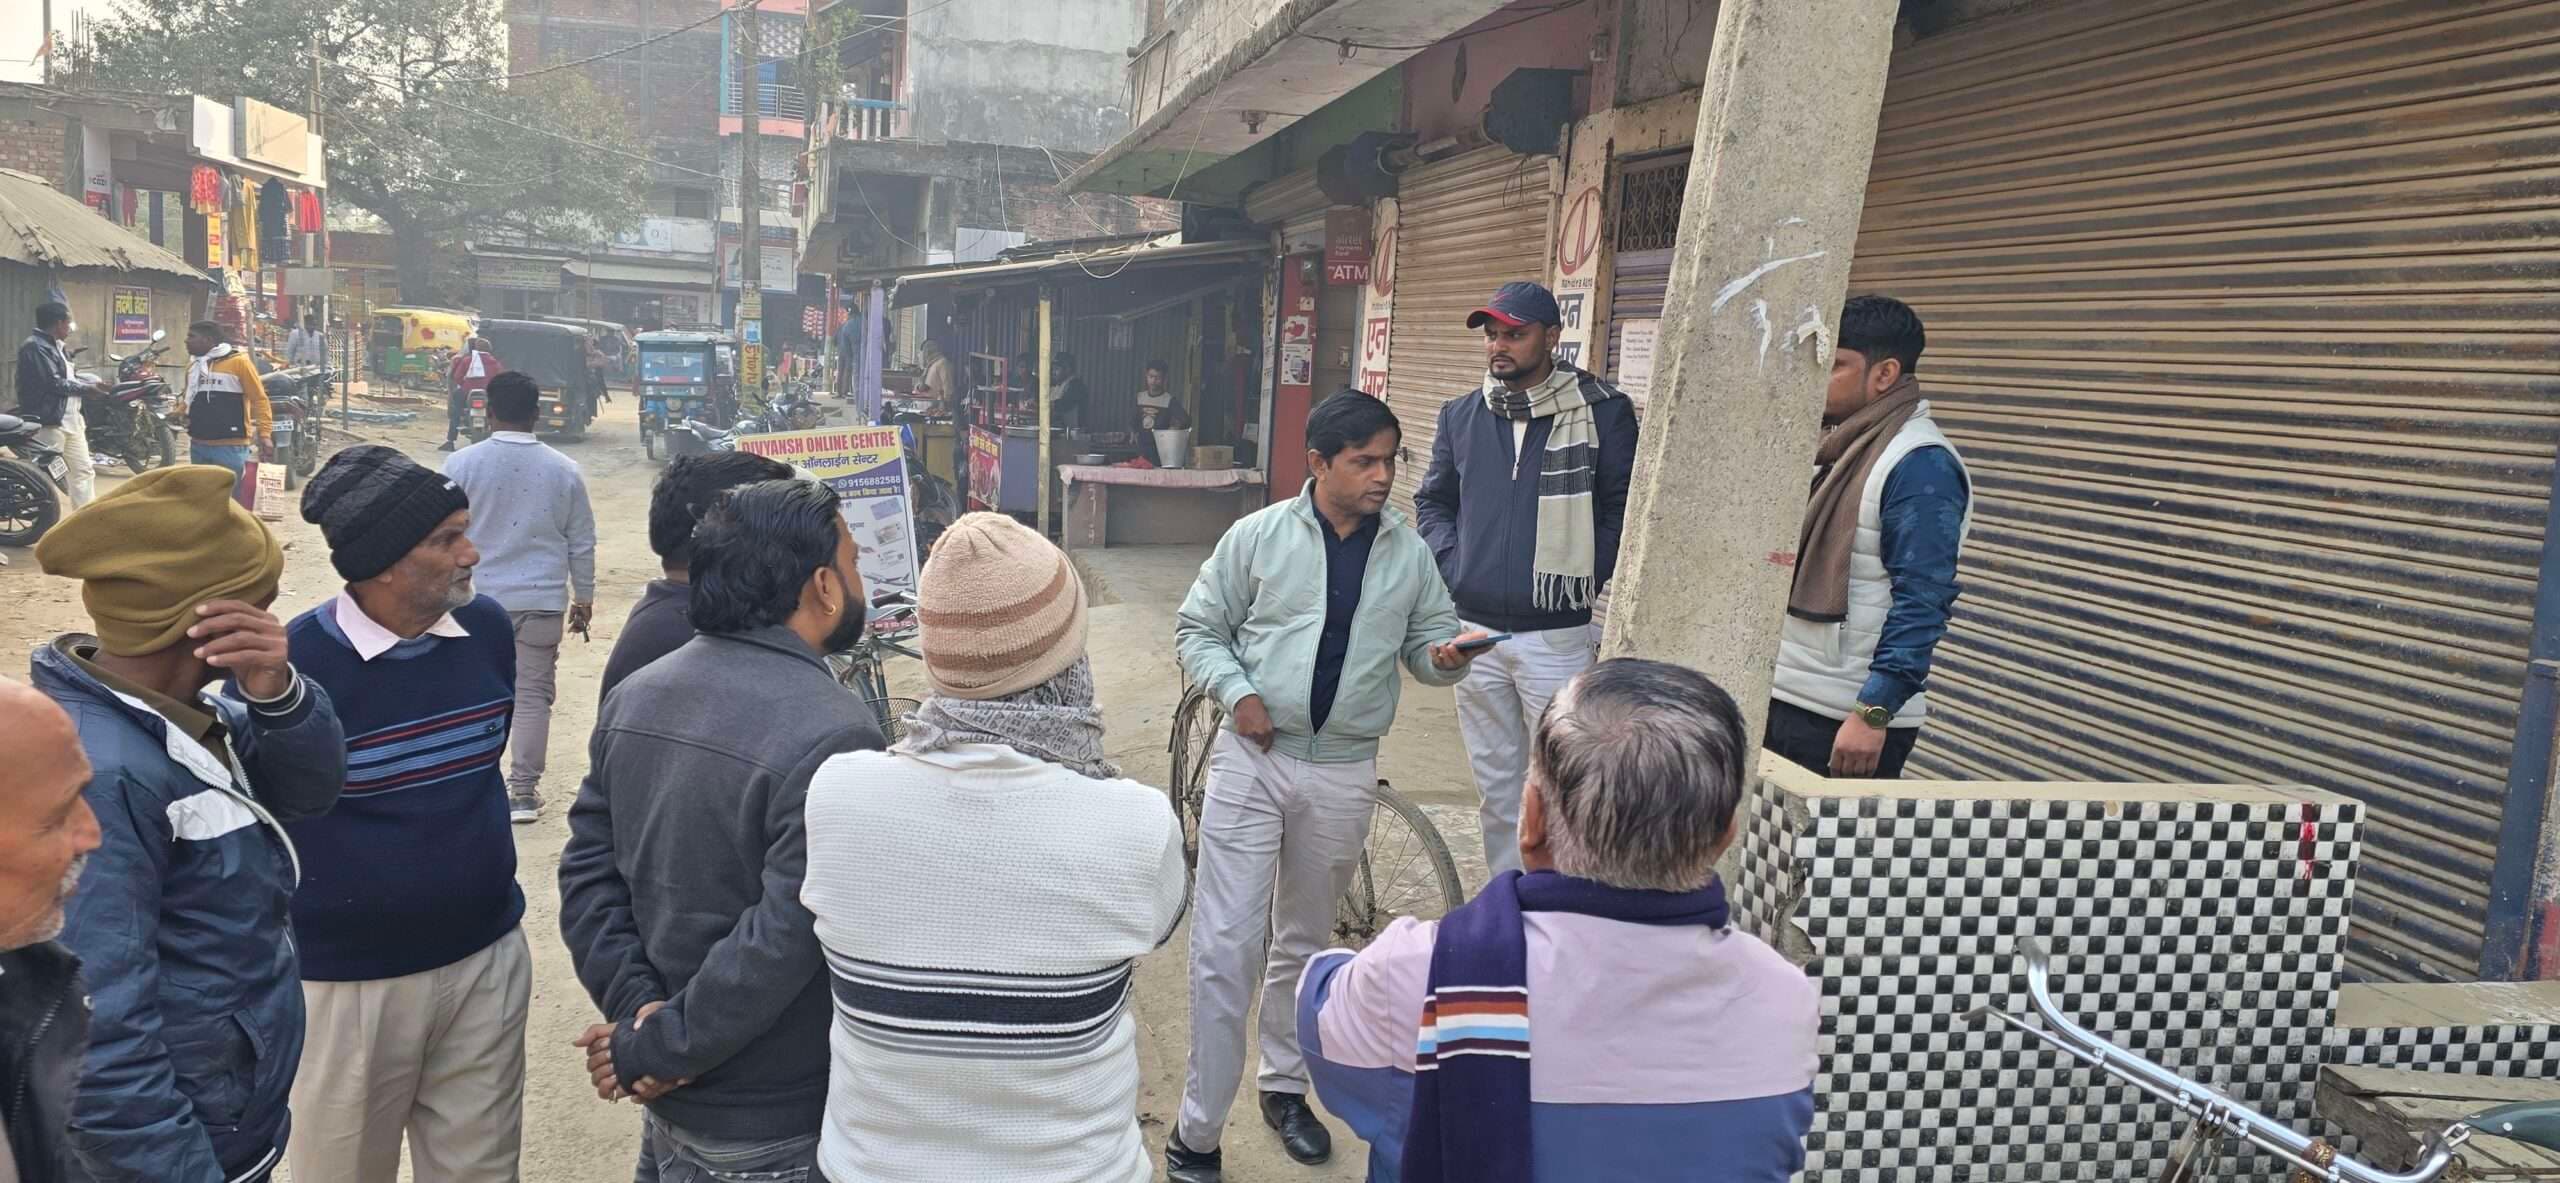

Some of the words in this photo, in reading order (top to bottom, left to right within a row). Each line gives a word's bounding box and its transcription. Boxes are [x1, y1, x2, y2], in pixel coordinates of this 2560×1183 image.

[1333, 265, 1369, 280] ATM
[1366, 317, 1389, 360] एन
[742, 435, 804, 457] DIVYANSH
[806, 434, 849, 453] ONLINE
[850, 431, 896, 449] CENTRE
